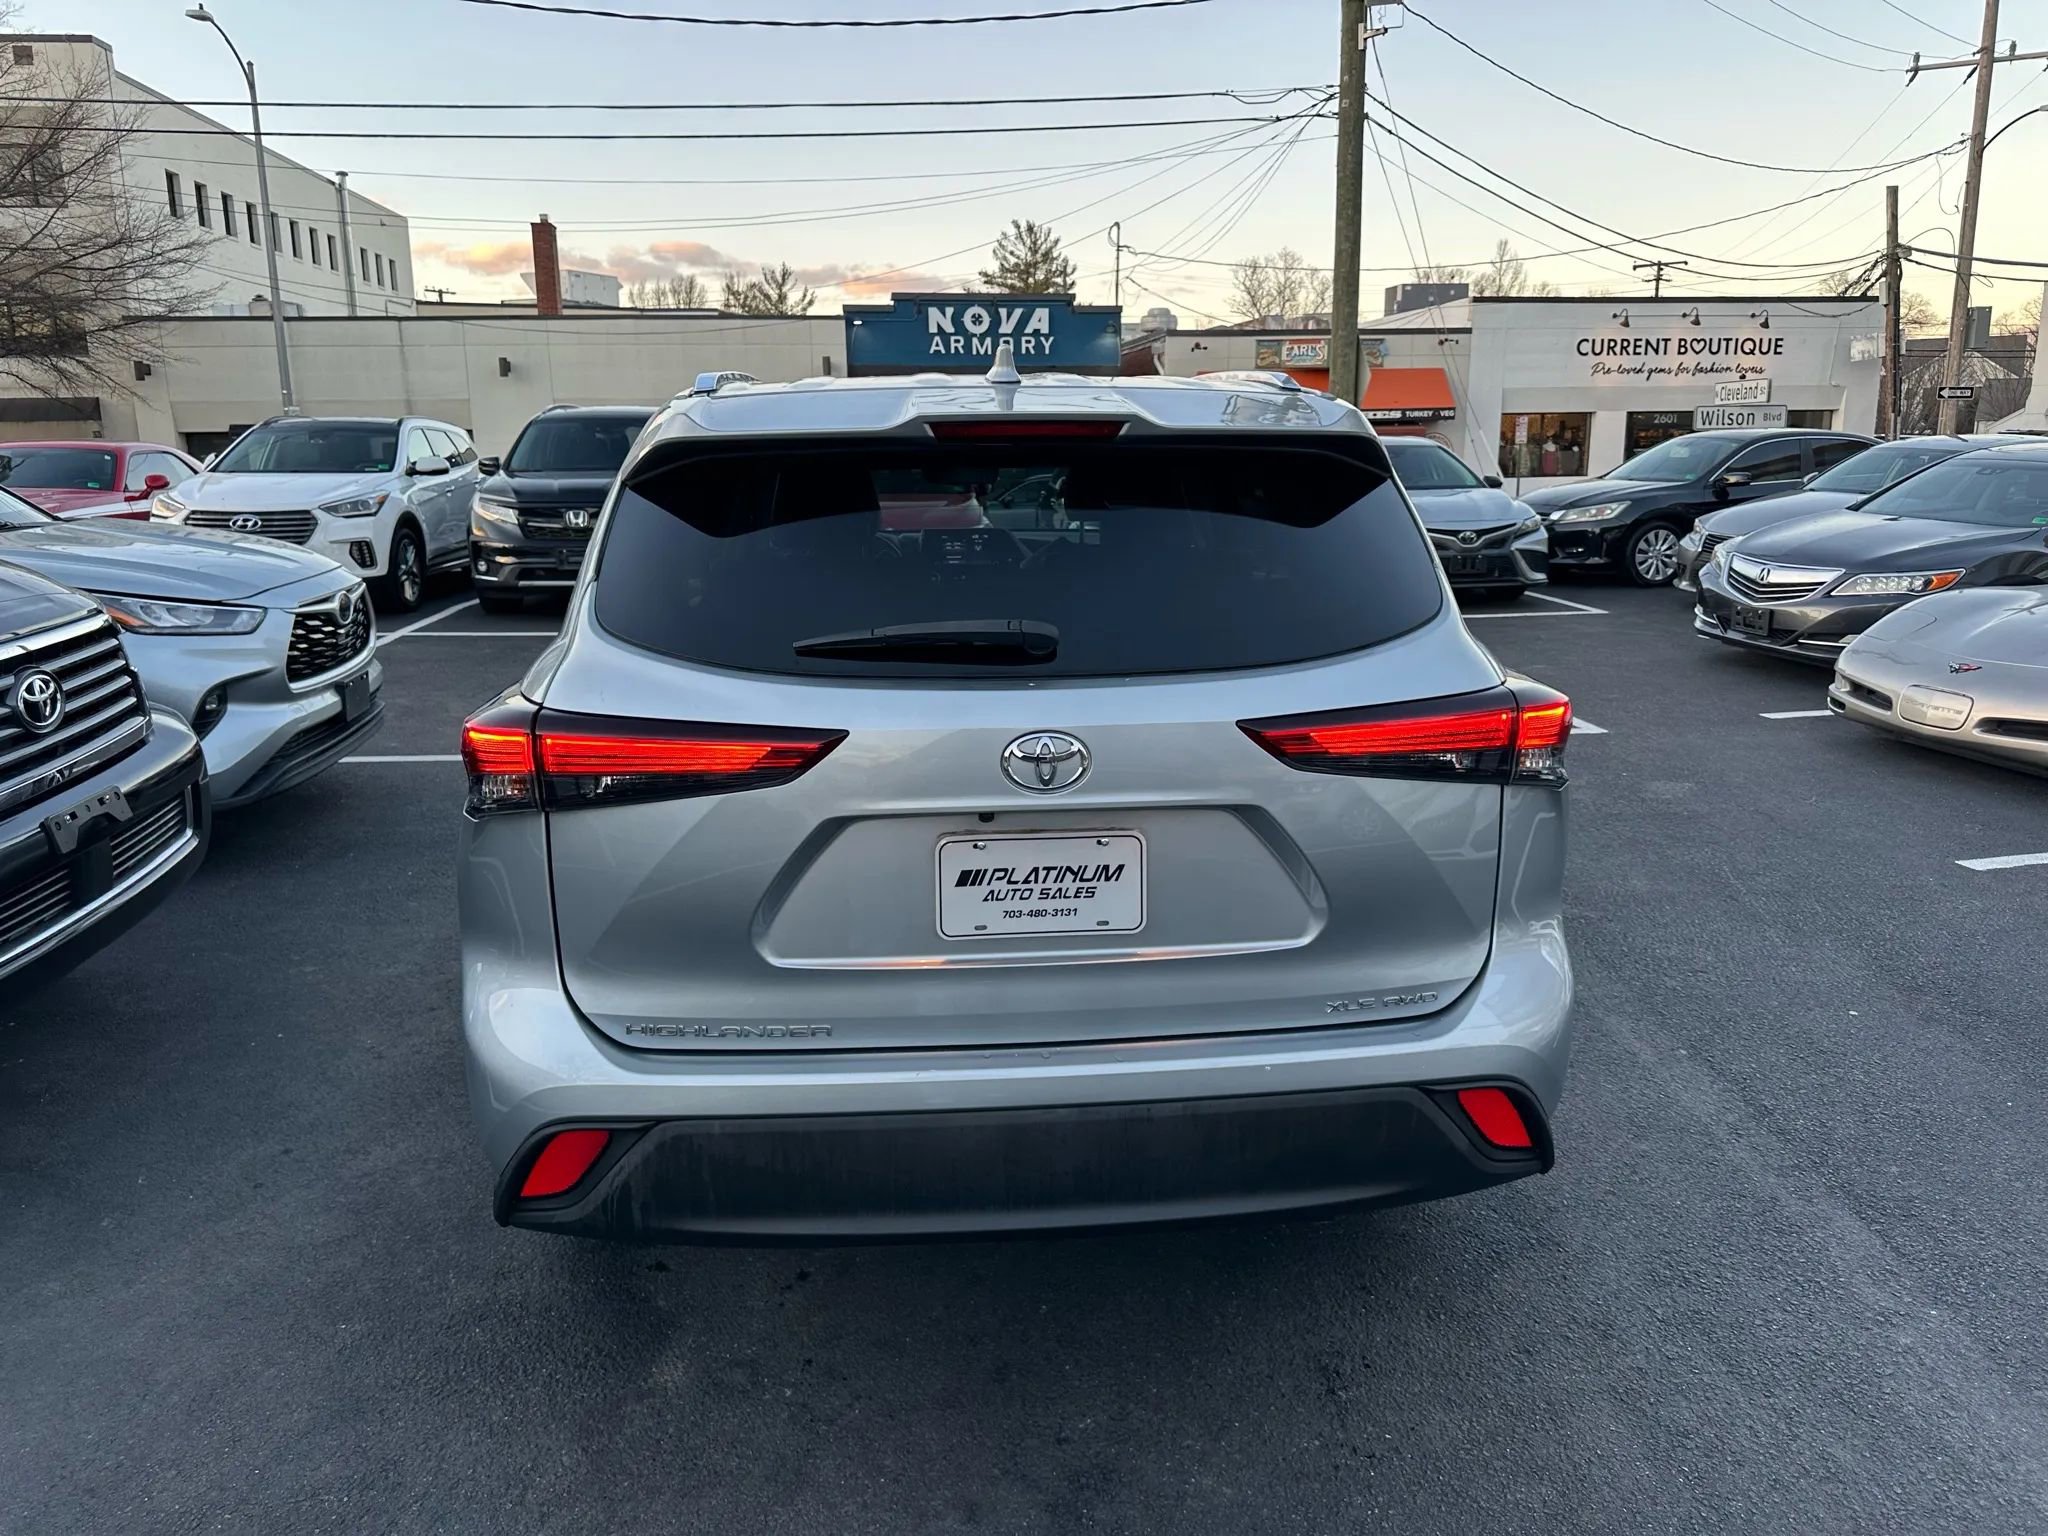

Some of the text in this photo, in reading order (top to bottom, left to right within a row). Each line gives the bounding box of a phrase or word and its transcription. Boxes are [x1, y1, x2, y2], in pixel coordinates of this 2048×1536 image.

[928, 305, 1049, 335] NOVA
[929, 336, 1054, 355] ARMORY
[1283, 342, 1325, 360] EARL'S
[1576, 337, 1784, 356] CURRENT BOUTIQUE
[1590, 360, 1767, 381] Pre-loved gems for fashion lovers
[1719, 382, 1759, 402] Cleveland
[1405, 410, 1434, 418] TURKEY
[1653, 413, 1678, 424] 2601
[1700, 408, 1782, 427] Wilson Blvd
[987, 864, 1126, 886] PLATINUM
[982, 886, 1098, 902] AUTO SALES
[1002, 907, 1078, 919] 703-480-3131
[1326, 998, 1376, 1013] XLE
[625, 1023, 832, 1038] HIGHLANDER
